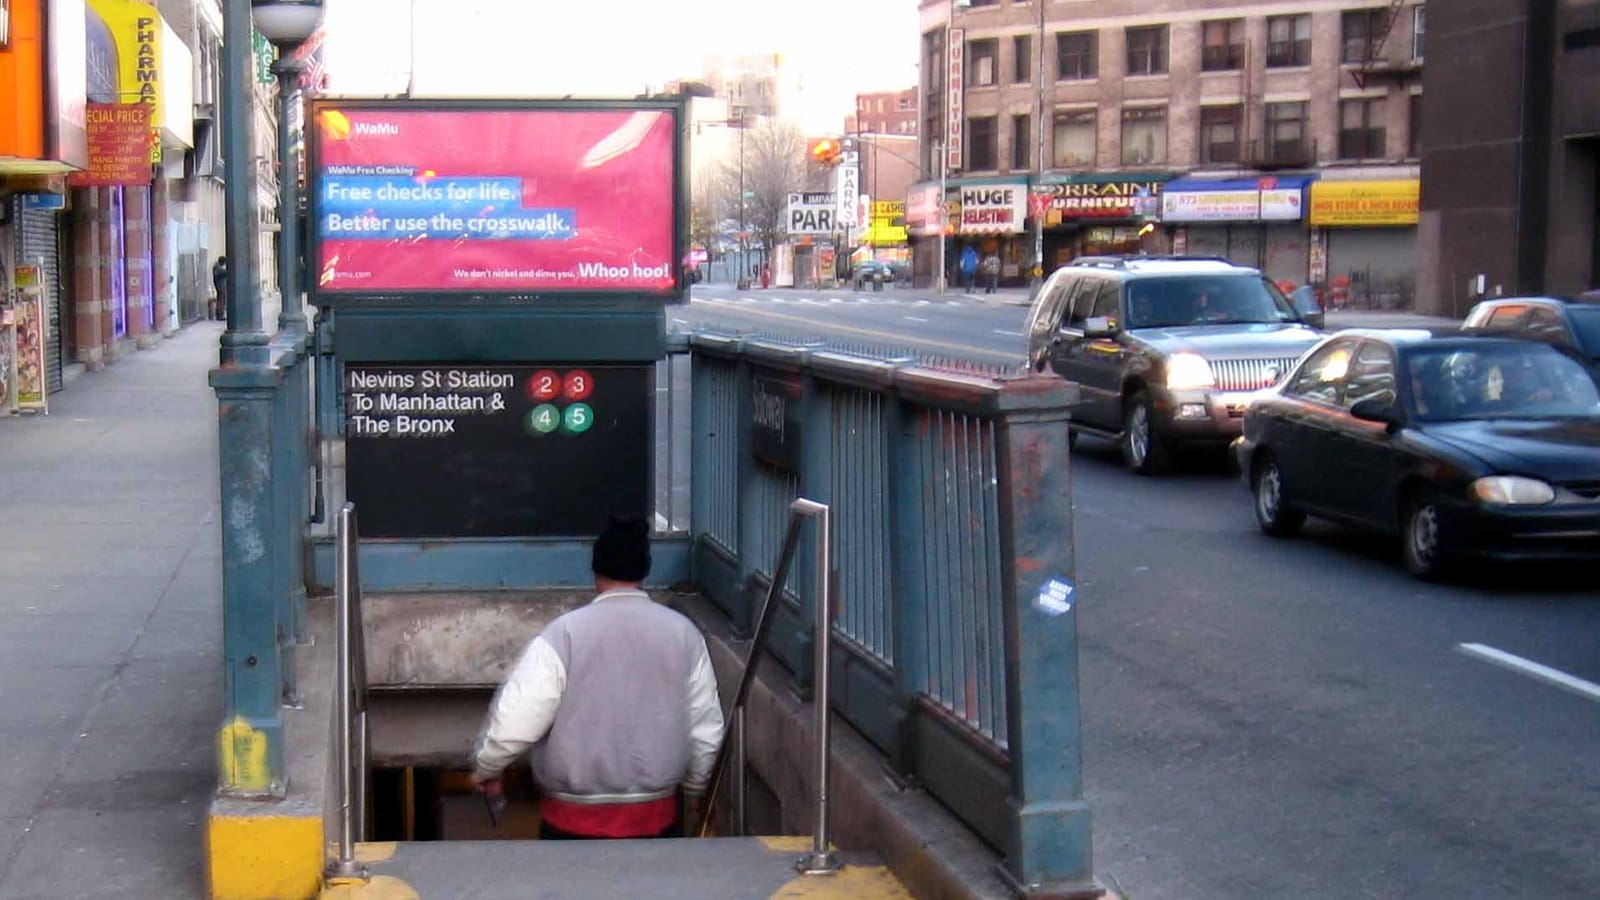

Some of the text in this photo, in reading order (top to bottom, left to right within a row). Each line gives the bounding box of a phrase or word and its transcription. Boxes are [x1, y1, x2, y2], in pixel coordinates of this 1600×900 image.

[137, 18, 158, 115] PHARMAC
[263, 36, 273, 80] AGE
[950, 31, 961, 166] FURNITURE
[87, 110, 144, 122] ECIAL PRICE
[355, 122, 398, 136] WaMu
[328, 166, 414, 177] WaMu Free Checking
[328, 183, 516, 200] Free checks for life.
[964, 190, 1014, 205] HUGE
[1054, 182, 1162, 196] ORRAINE
[880, 203, 905, 214] CASHE
[1053, 196, 1148, 208] URNITUR
[328, 213, 570, 232] Better use the crosswalk.
[454, 269, 469, 278] We
[470, 268, 491, 278] don't
[492, 268, 518, 278] nickel
[518, 268, 534, 278] and
[535, 268, 556, 278] dime
[578, 262, 630, 279] Whoo
[632, 262, 670, 279] hoo!
[351, 370, 585, 393] Nevins St Station 2 3
[352, 394, 506, 410] To Manhattan &
[352, 416, 455, 433] The Bronx
[539, 407, 586, 425] 4 5
